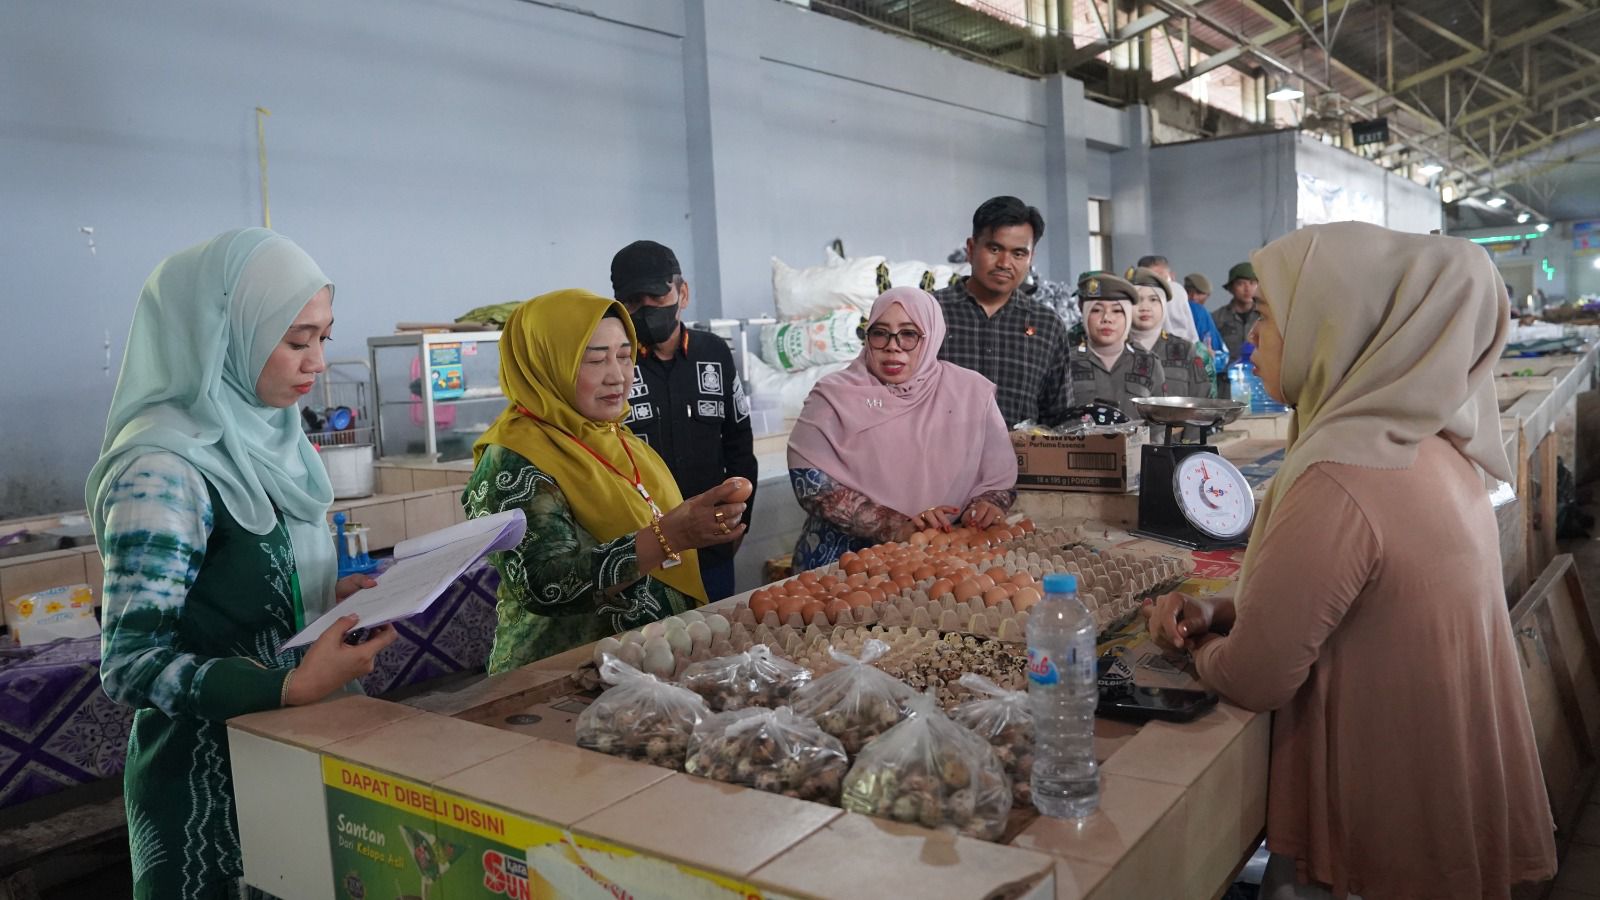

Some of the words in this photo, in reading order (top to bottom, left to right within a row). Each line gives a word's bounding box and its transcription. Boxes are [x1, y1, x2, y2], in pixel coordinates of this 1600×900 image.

[1359, 131, 1383, 143] EXIT
[1071, 477, 1101, 485] POWDER
[341, 768, 389, 798] DAPAT
[394, 786, 449, 817] DIBELI
[452, 803, 505, 836] DISINI
[337, 813, 386, 847] Santan
[338, 835, 354, 849] Dari
